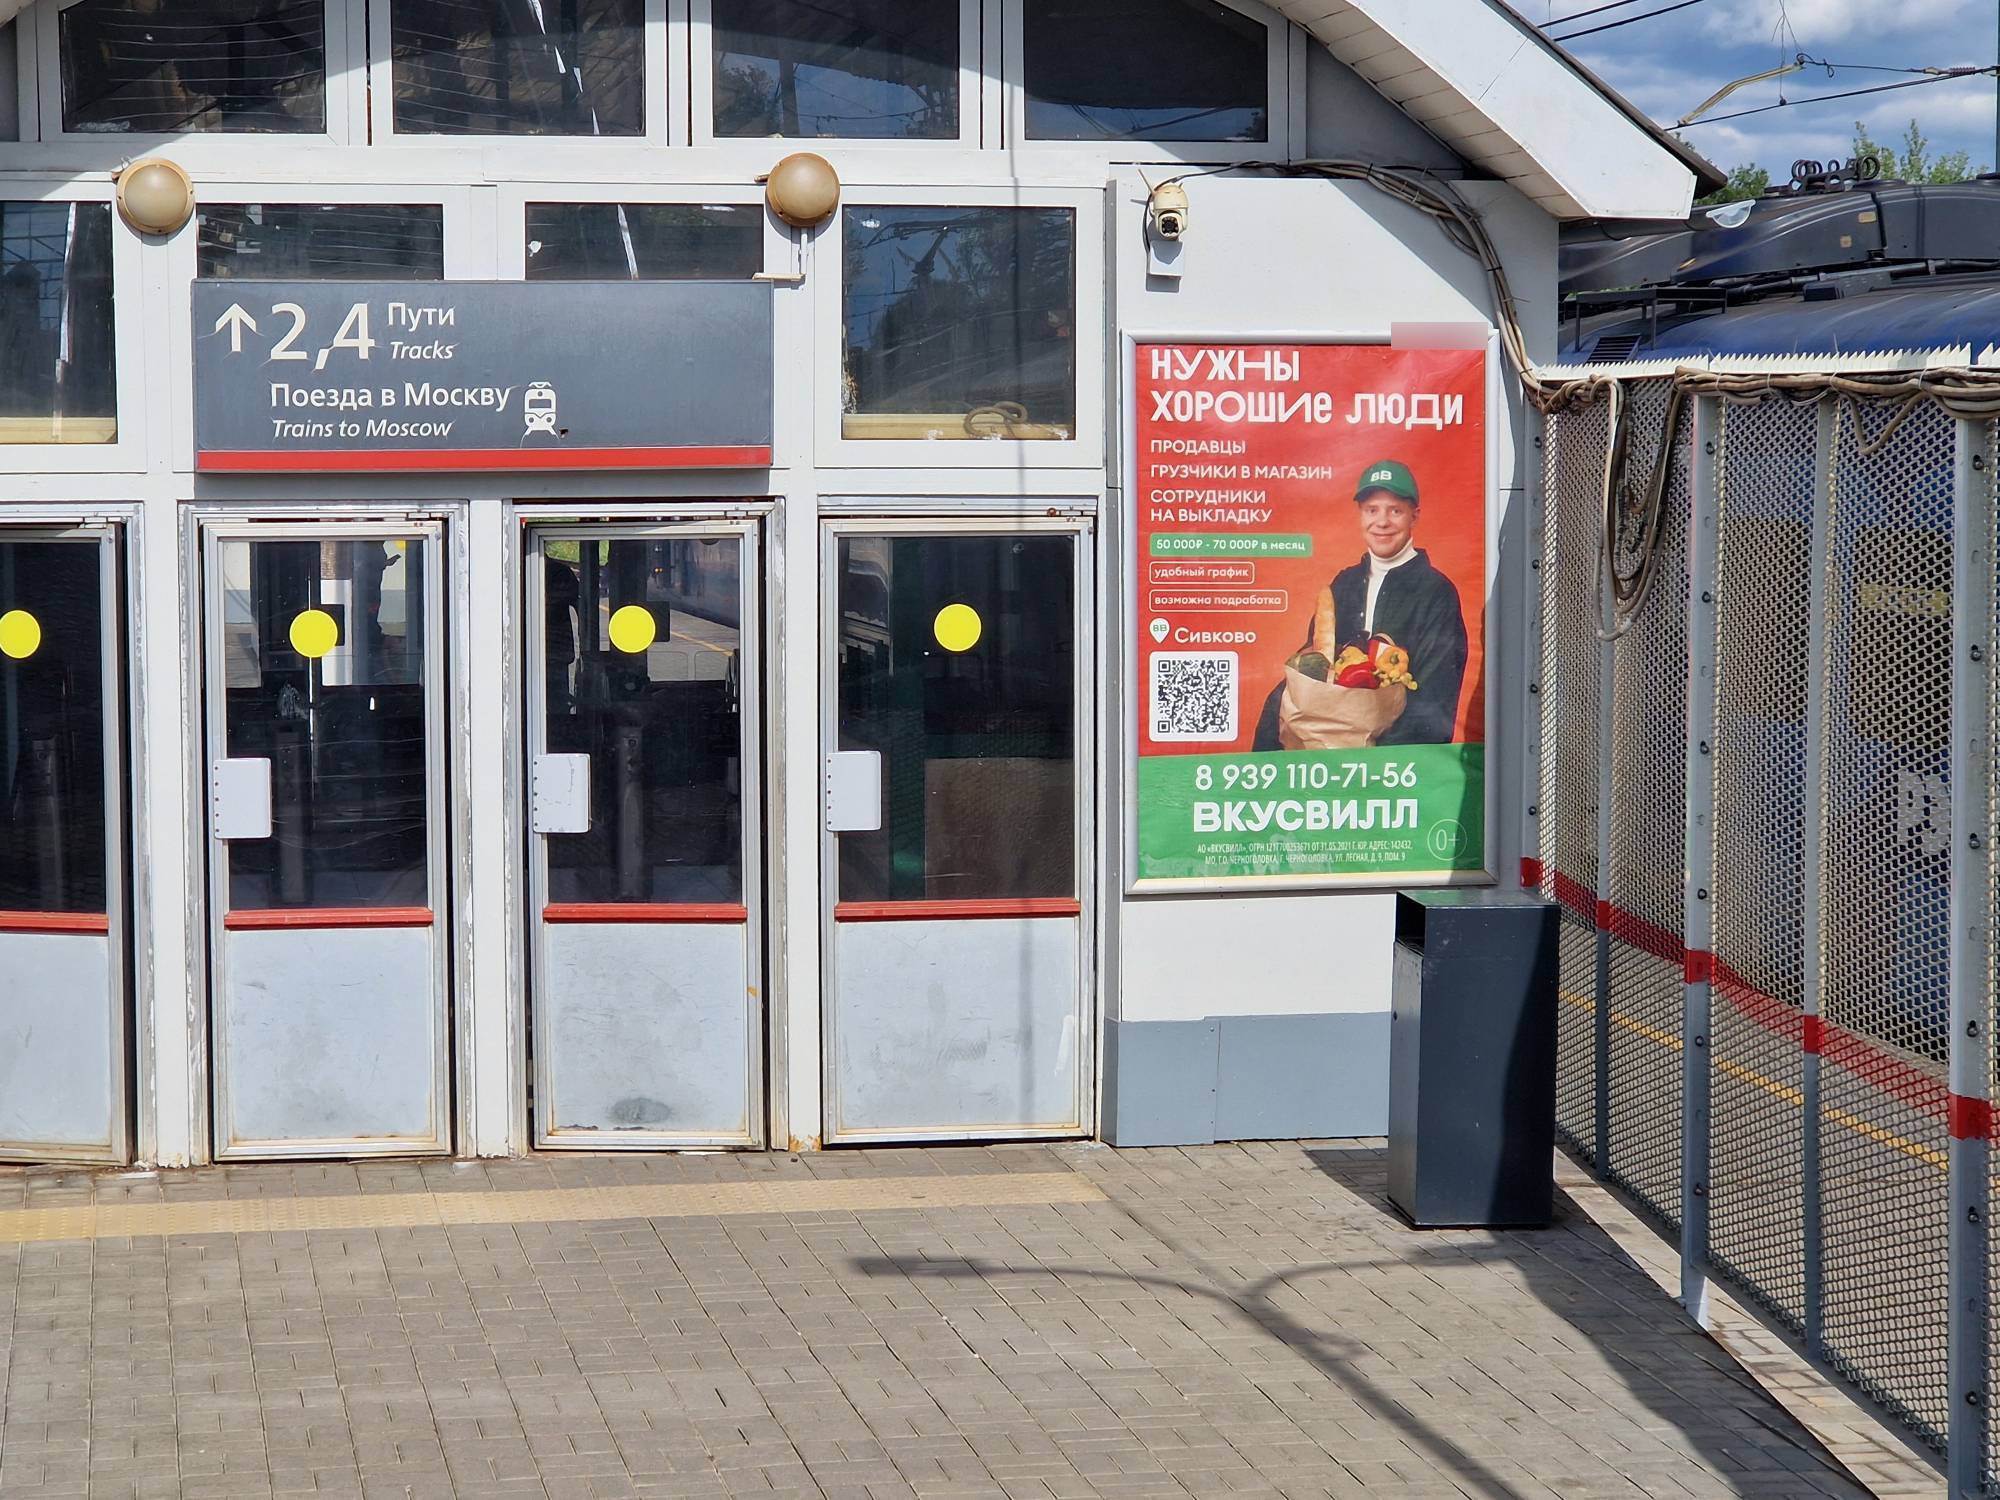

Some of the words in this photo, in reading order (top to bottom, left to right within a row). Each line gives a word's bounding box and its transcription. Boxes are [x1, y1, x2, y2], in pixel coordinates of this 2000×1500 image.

[388, 302, 455, 332] Пути
[391, 339, 453, 360] Tracks
[1151, 349, 1300, 382] НУЖНЫ
[270, 382, 374, 411] Поезда
[381, 389, 396, 406] в
[404, 382, 509, 412] Москву
[1345, 393, 1463, 430] ЛЮДИ
[272, 419, 334, 438] Trains
[339, 420, 359, 438] to
[366, 419, 451, 438] Moscow
[1150, 440, 1246, 455] ПРОДАВЦЫ
[1150, 464, 1237, 480] ГРУЗЧИКИ
[1241, 466, 1250, 479] В
[1254, 466, 1332, 480] МАГАЗИН
[1150, 489, 1266, 506] СОТРУДНИКИ
[1150, 508, 1175, 522] НА
[1179, 508, 1272, 525] ВЫКЛАДКУ
[1156, 539, 1171, 550] 50
[1213, 539, 1227, 550] 70
[1261, 542, 1268, 550] в
[1271, 542, 1305, 552] месяц
[1154, 566, 1205, 579] удобный
[1207, 567, 1249, 579] график
[1154, 596, 1211, 605] возможна
[1214, 595, 1281, 607] подработка
[1174, 628, 1256, 644] Сивково
[1195, 764, 1213, 791] 8
[1222, 764, 1277, 791] 939
[1286, 762, 1417, 789] 110-71-56
[1193, 799, 1418, 833] ВКУСВИЛЛ
[1198, 844, 1206, 853] АО
[1435, 829, 1460, 850] 0+
